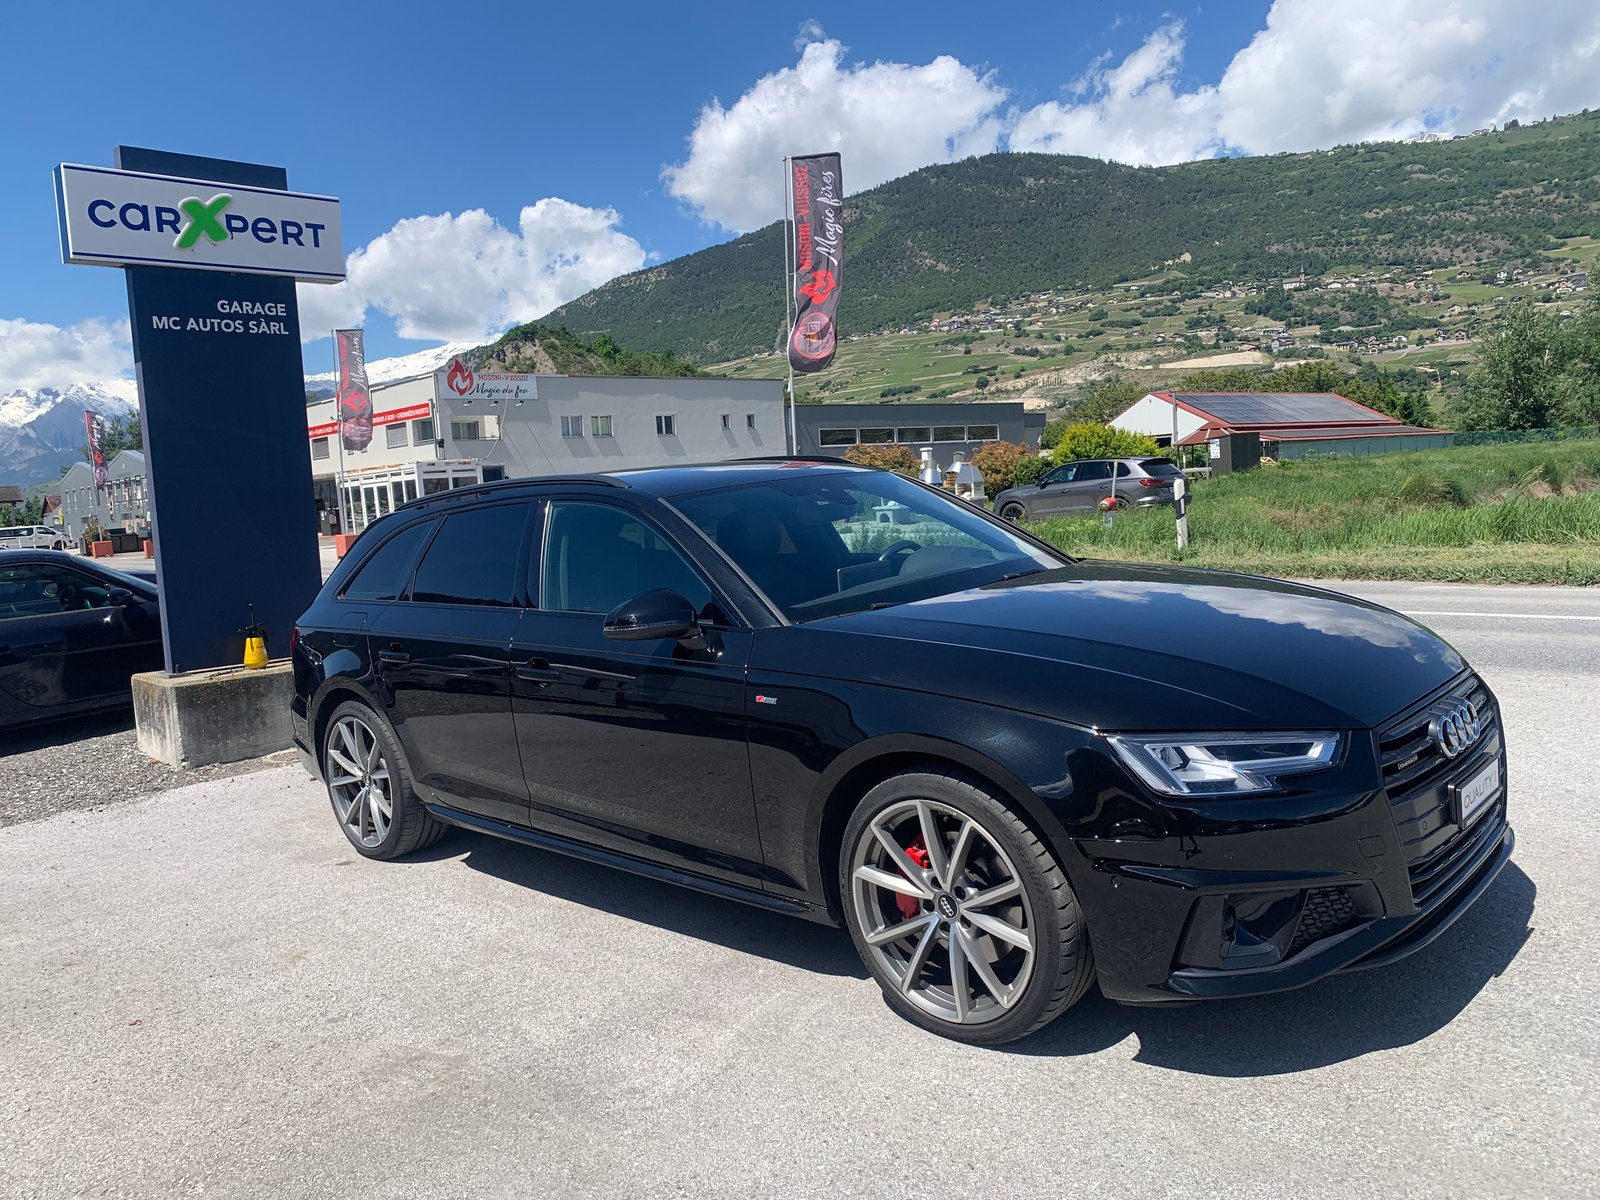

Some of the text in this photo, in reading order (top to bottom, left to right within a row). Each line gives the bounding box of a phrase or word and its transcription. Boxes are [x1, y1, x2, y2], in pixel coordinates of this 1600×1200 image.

[795, 165, 812, 271] MOSONI-VUISSOZ
[814, 171, 843, 266] Magic fires
[217, 300, 287, 316] GARAGE
[152, 315, 289, 335] MC AUTOS SÀRL
[469, 382, 528, 398] Magie du feu
[1464, 773, 1492, 809] QUALITY
